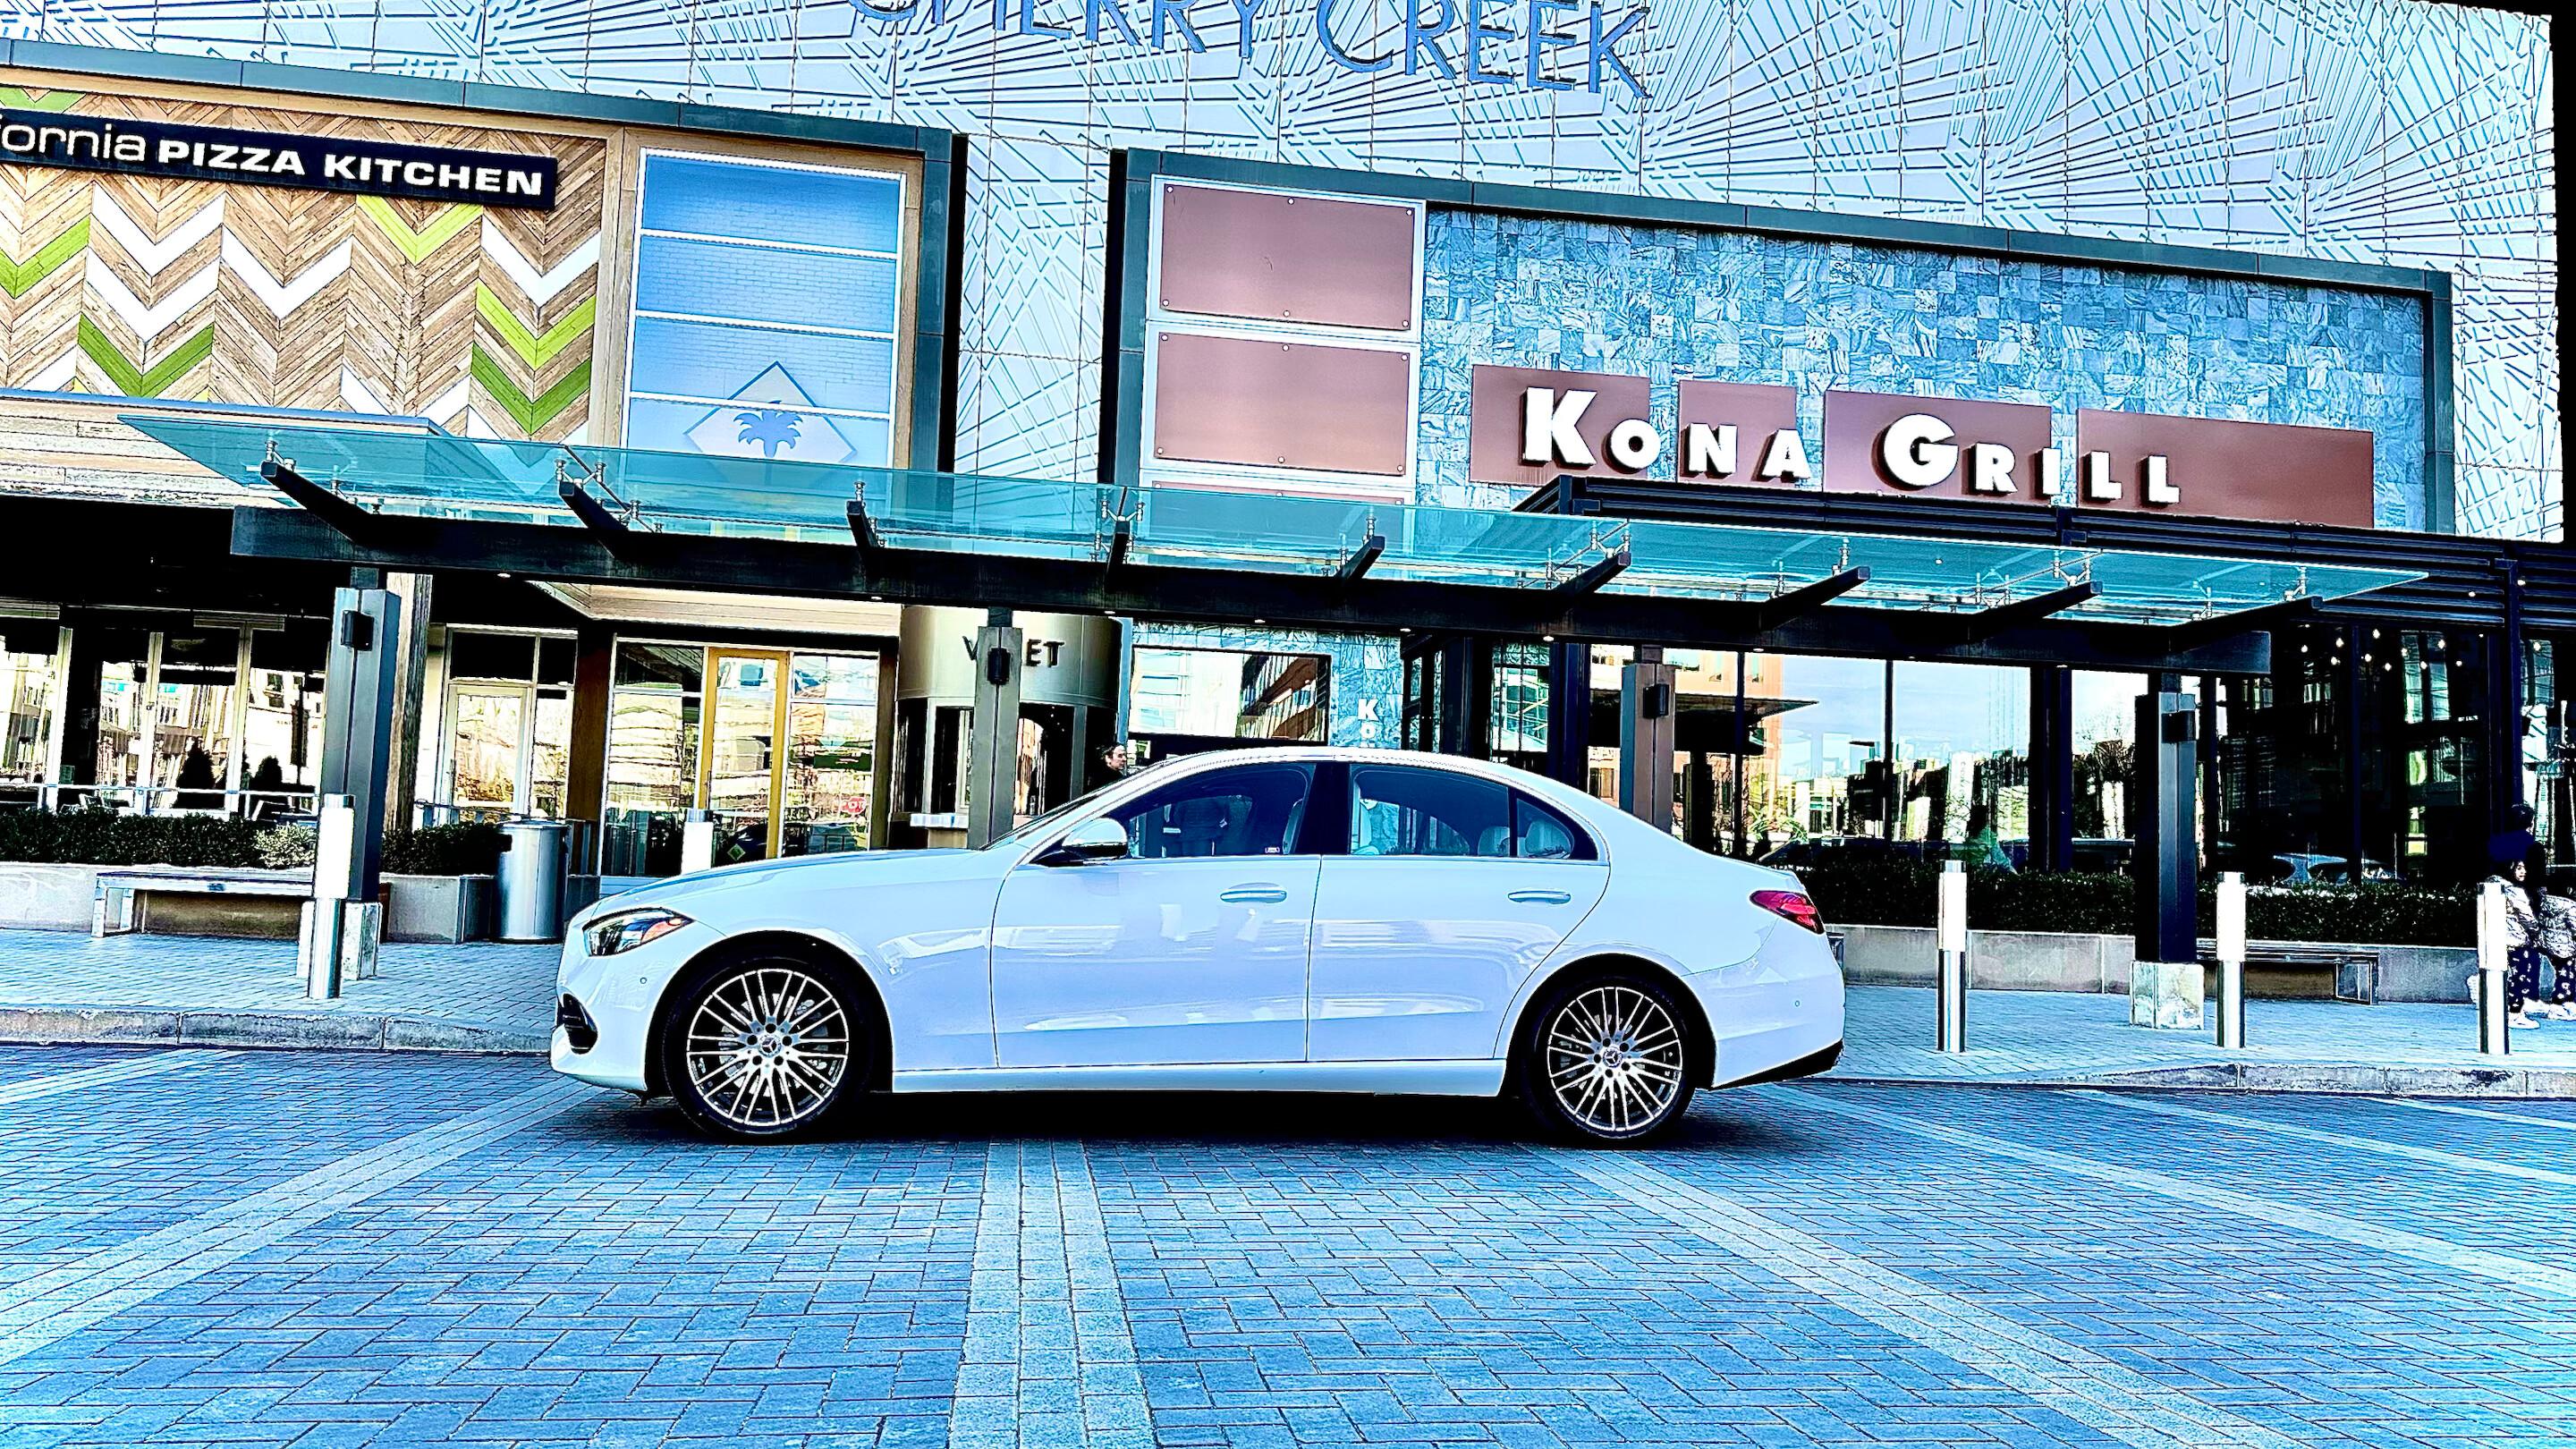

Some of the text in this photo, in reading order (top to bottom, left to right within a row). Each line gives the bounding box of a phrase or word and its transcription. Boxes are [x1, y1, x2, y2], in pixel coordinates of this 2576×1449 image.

[1316, 0, 1653, 98] CREEK
[0, 114, 542, 196] ornia PIZZA KITCHEN
[962, 635, 1065, 667] VET
